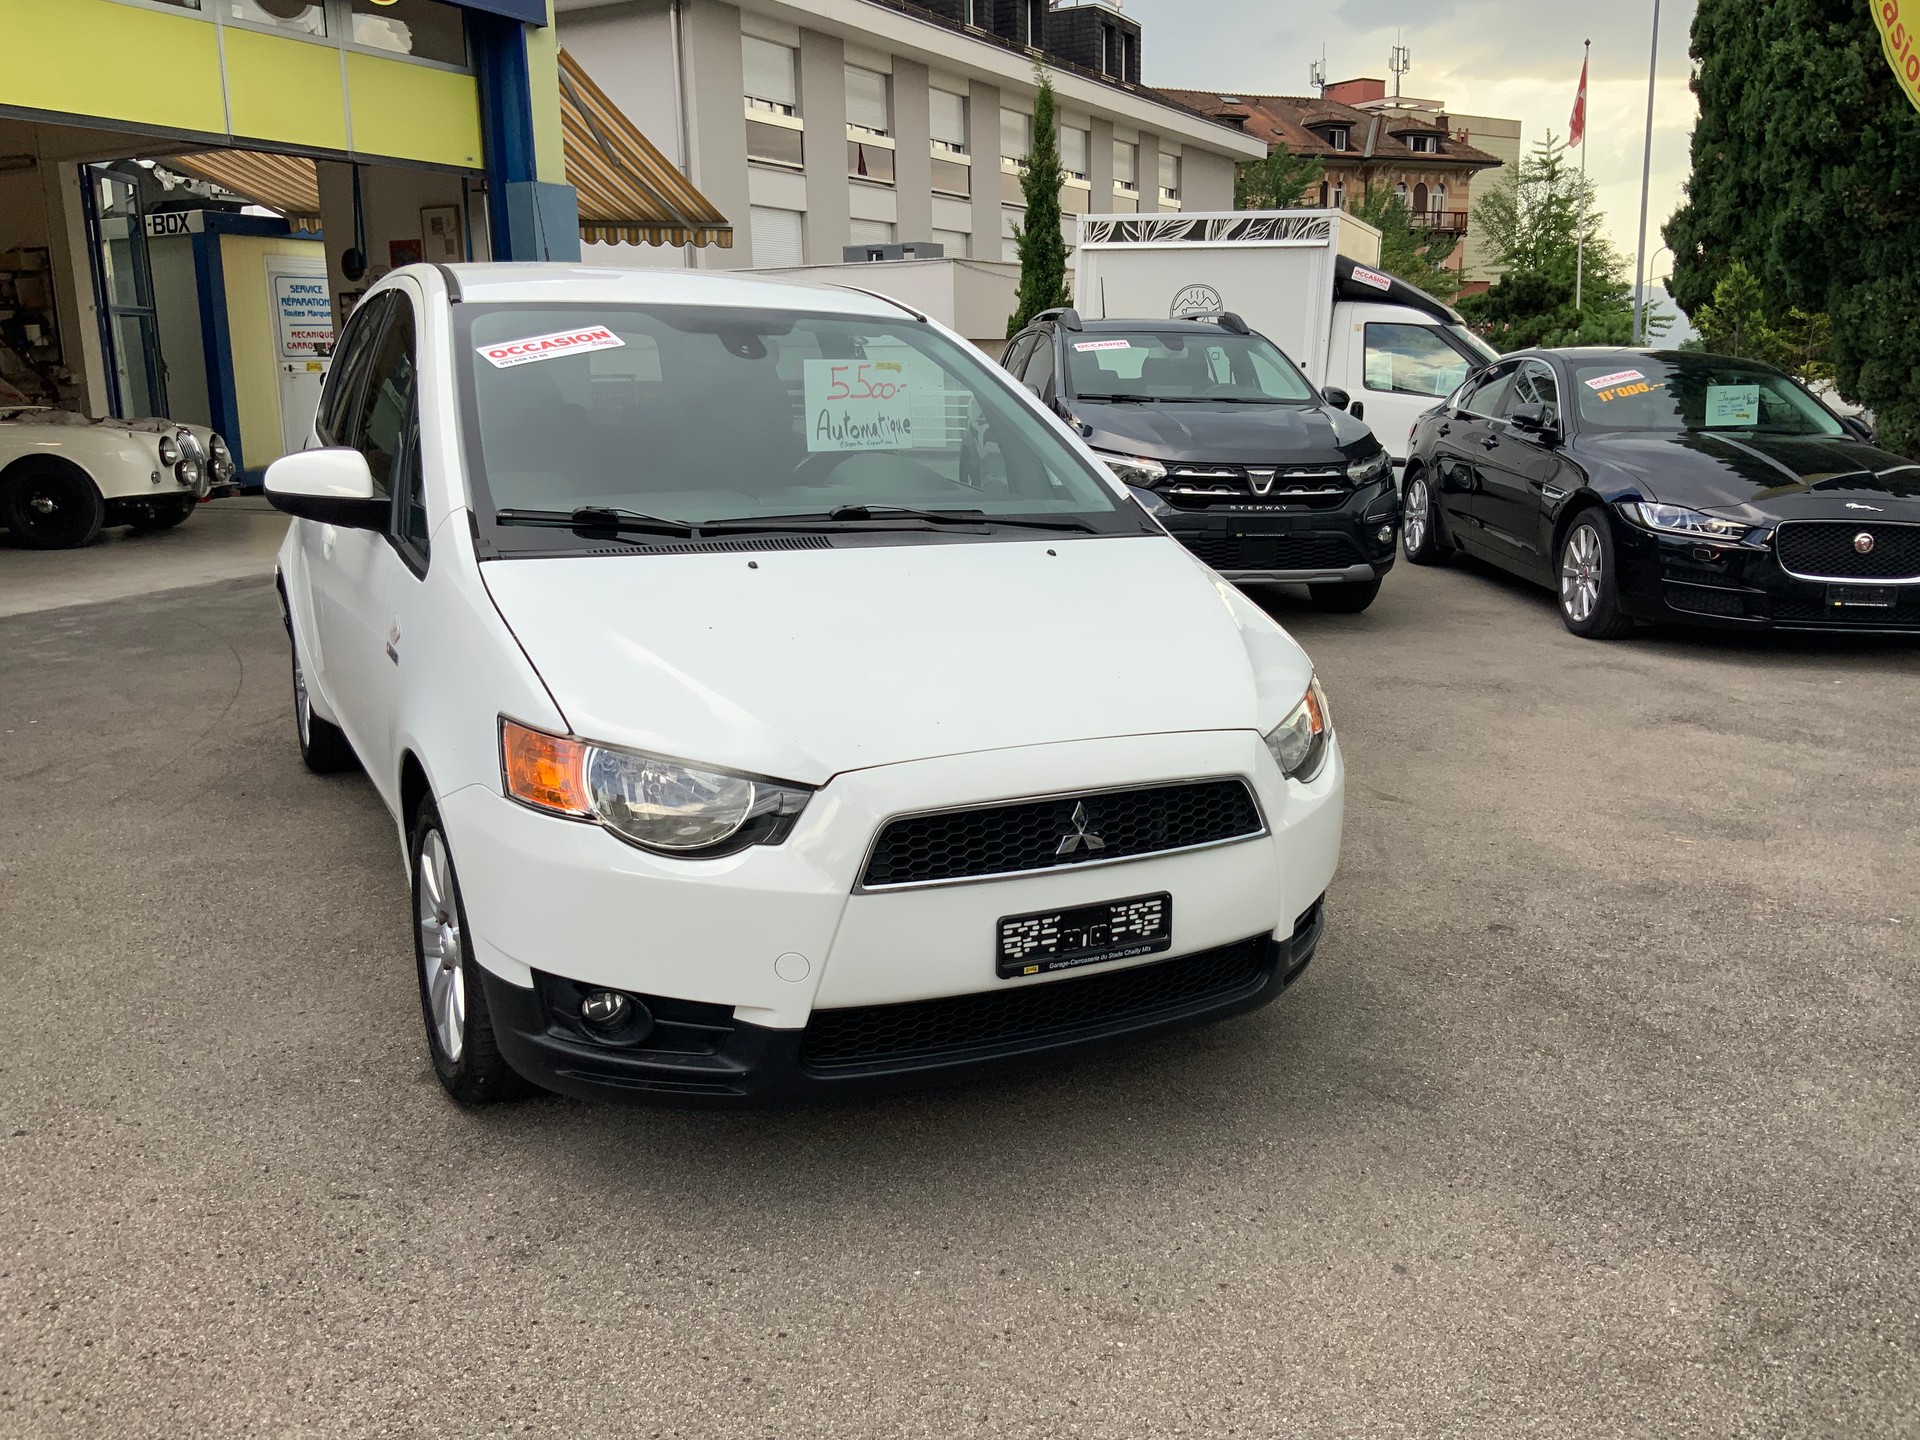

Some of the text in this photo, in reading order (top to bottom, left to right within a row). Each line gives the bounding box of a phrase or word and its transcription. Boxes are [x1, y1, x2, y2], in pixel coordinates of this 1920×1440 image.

[1355, 270, 1389, 285] OCCASION
[290, 285, 323, 293] SERVICE
[284, 309, 305, 317] Toutes
[488, 331, 611, 358] OCCASION
[1590, 371, 1638, 386] OCCASION
[817, 409, 911, 444] Automatique
[1049, 956, 1100, 969] Garage-Carrosserie
